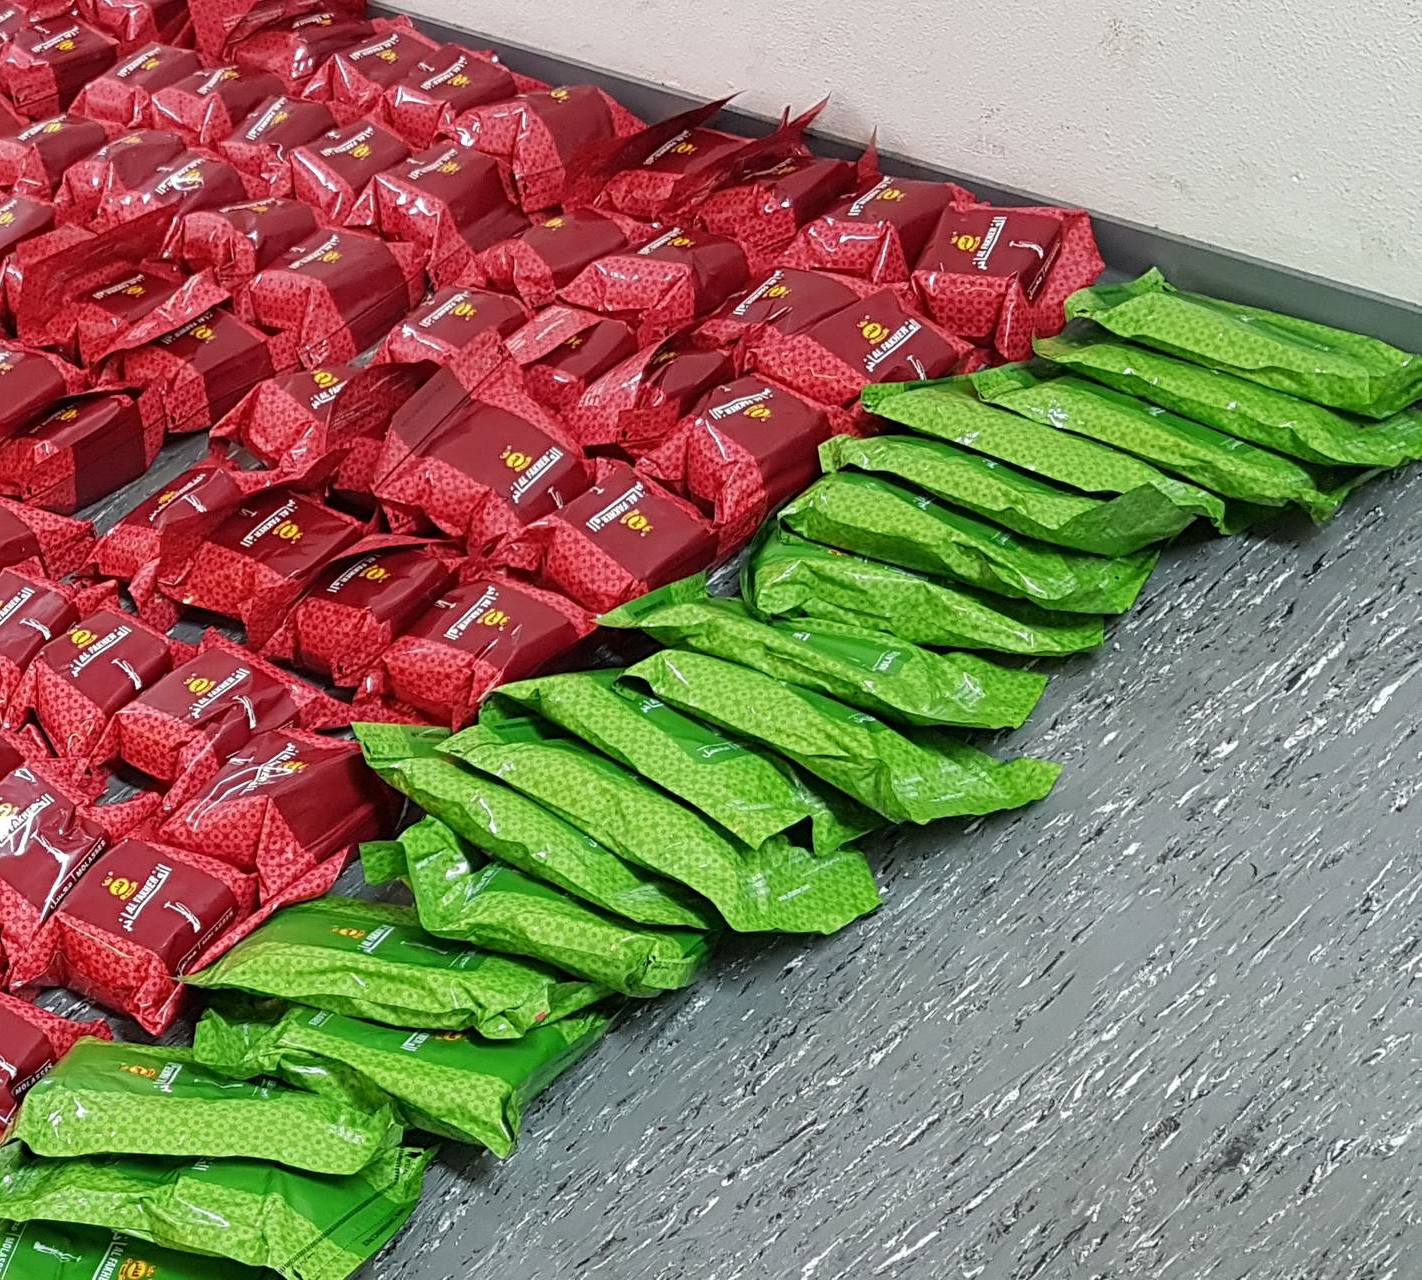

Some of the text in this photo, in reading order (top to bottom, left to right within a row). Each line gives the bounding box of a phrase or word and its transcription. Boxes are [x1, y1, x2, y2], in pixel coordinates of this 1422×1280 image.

[872, 326, 911, 359] AL FAKHER
[518, 455, 553, 487] AL FAKHER
[601, 491, 638, 523] AL FAKHER
[251, 509, 289, 537] AL FAKHER
[478, 597, 491, 608] AL
[79, 633, 119, 663] AL FAKHER
[198, 677, 238, 707] AL FAKHER
[76, 840, 106, 877] MOLASSES
[125, 876, 159, 914] AL FAKHER
[114, 1245, 125, 1258] AL
